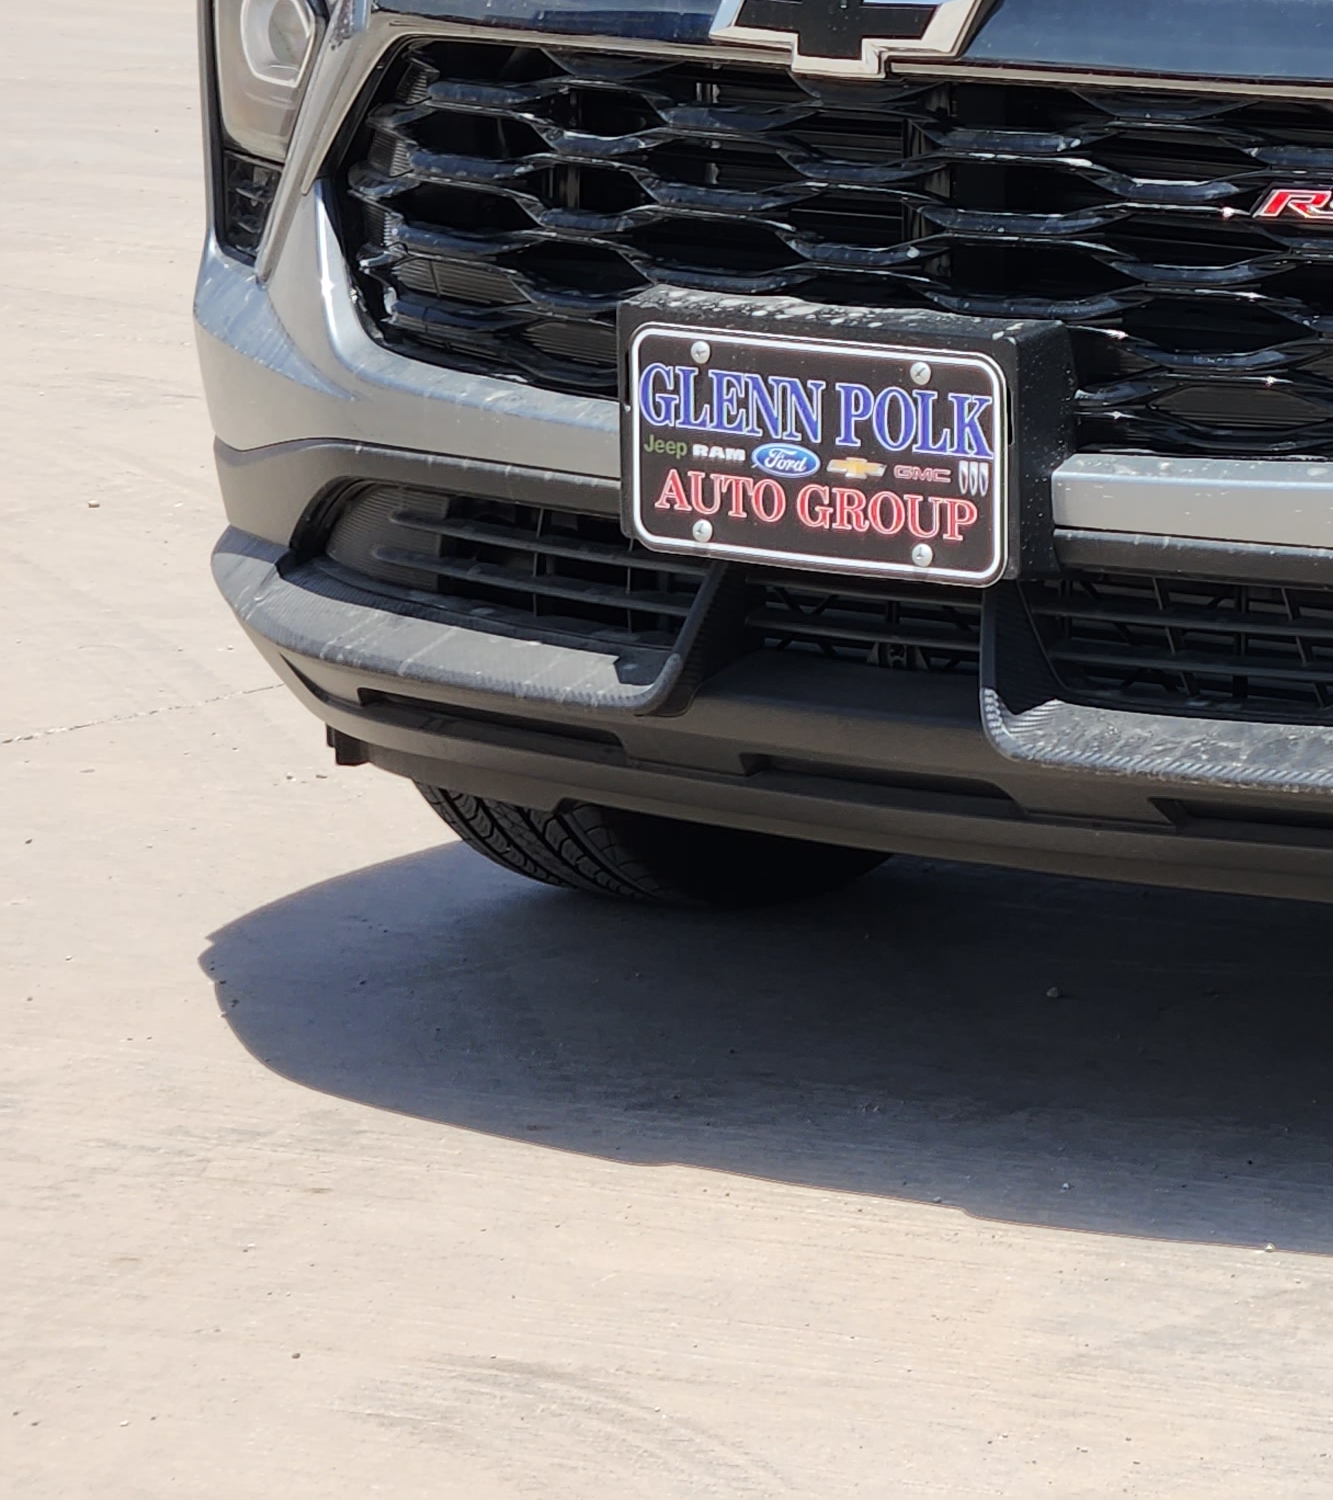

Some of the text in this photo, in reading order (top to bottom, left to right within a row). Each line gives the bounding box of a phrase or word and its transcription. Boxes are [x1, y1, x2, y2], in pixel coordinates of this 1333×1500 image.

[639, 361, 995, 461] GLENN POLK
[643, 433, 952, 484] Jeep RAM Ford GMC
[654, 468, 979, 542] AUTO GROUP
